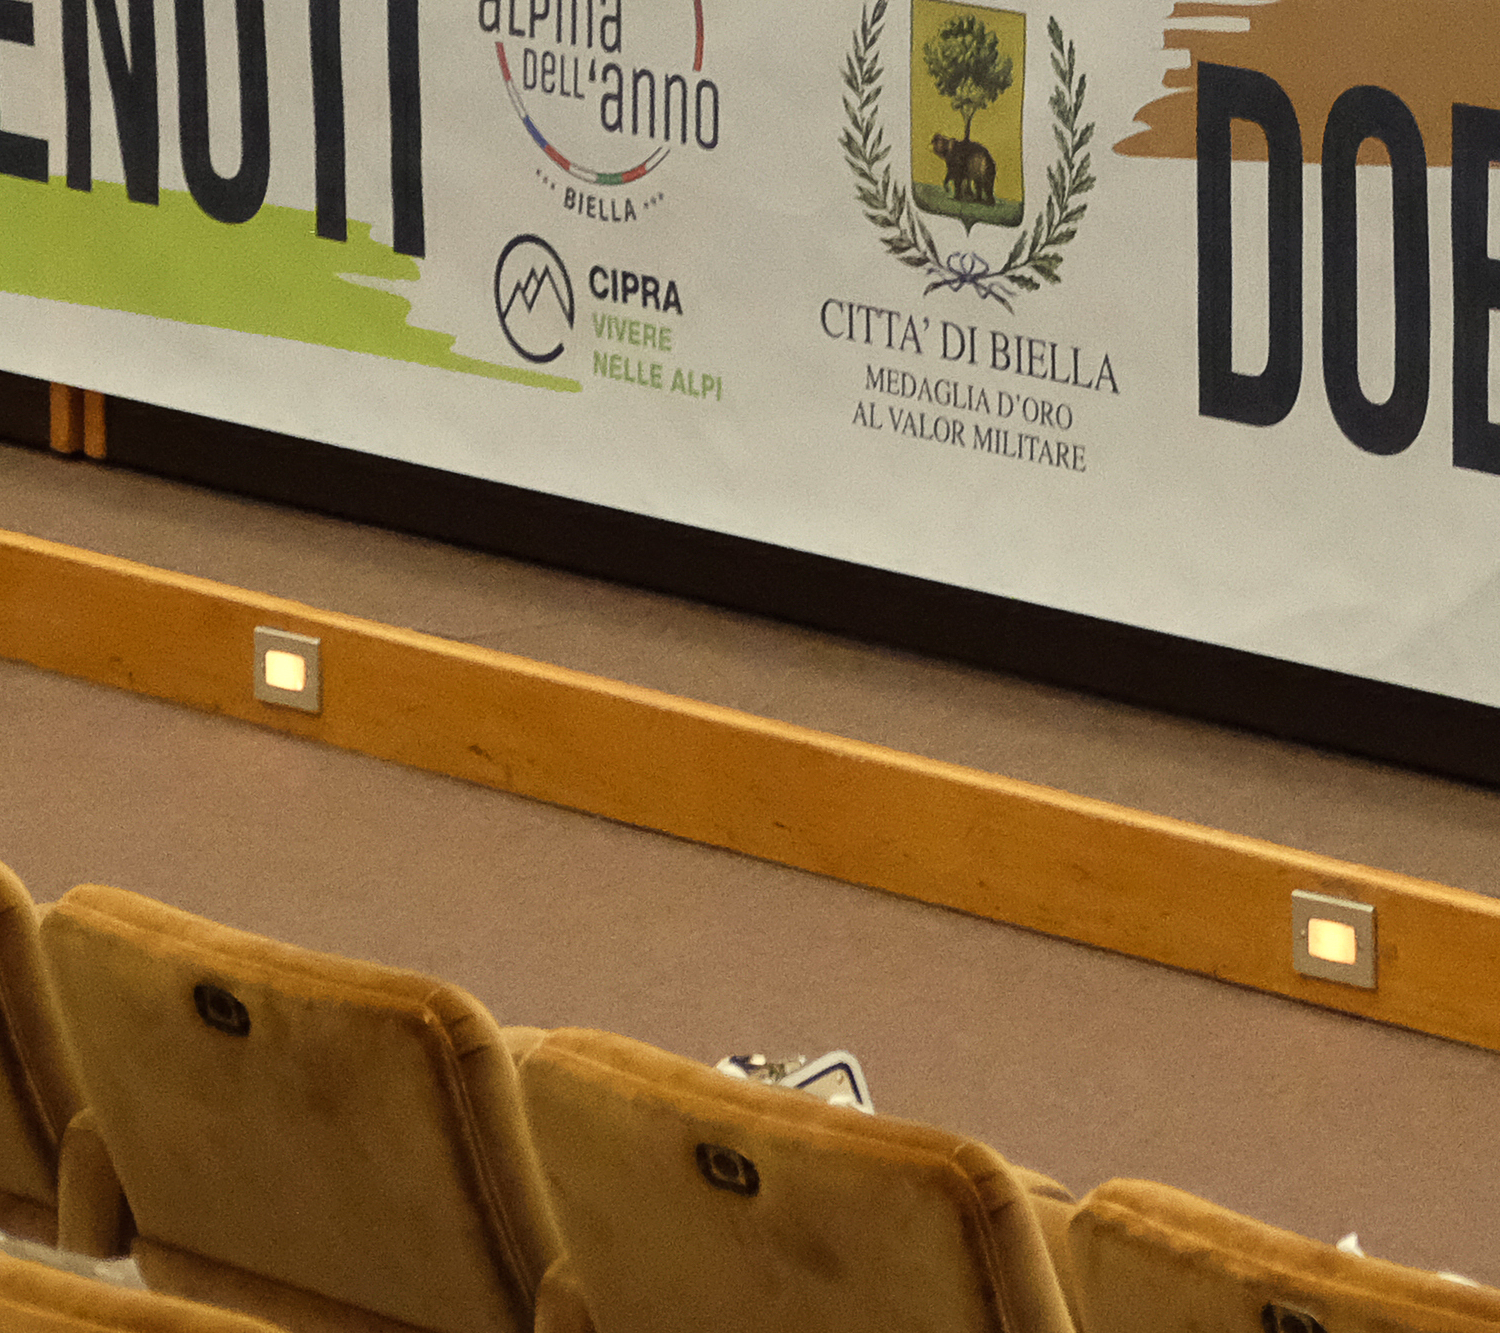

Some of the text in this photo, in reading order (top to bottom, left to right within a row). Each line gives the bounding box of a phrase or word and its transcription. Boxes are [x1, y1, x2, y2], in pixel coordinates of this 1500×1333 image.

[564, 185, 638, 223] BIELLA
[588, 265, 684, 315] CIPRA
[592, 312, 672, 353] VIVERE
[820, 297, 1120, 394] CITTA' DI BIELLA
[593, 351, 723, 401] NELLE ALPI
[864, 364, 1073, 431] MEDAGLIA D'ORO
[851, 402, 1087, 473] AL VALOR MILITARE
